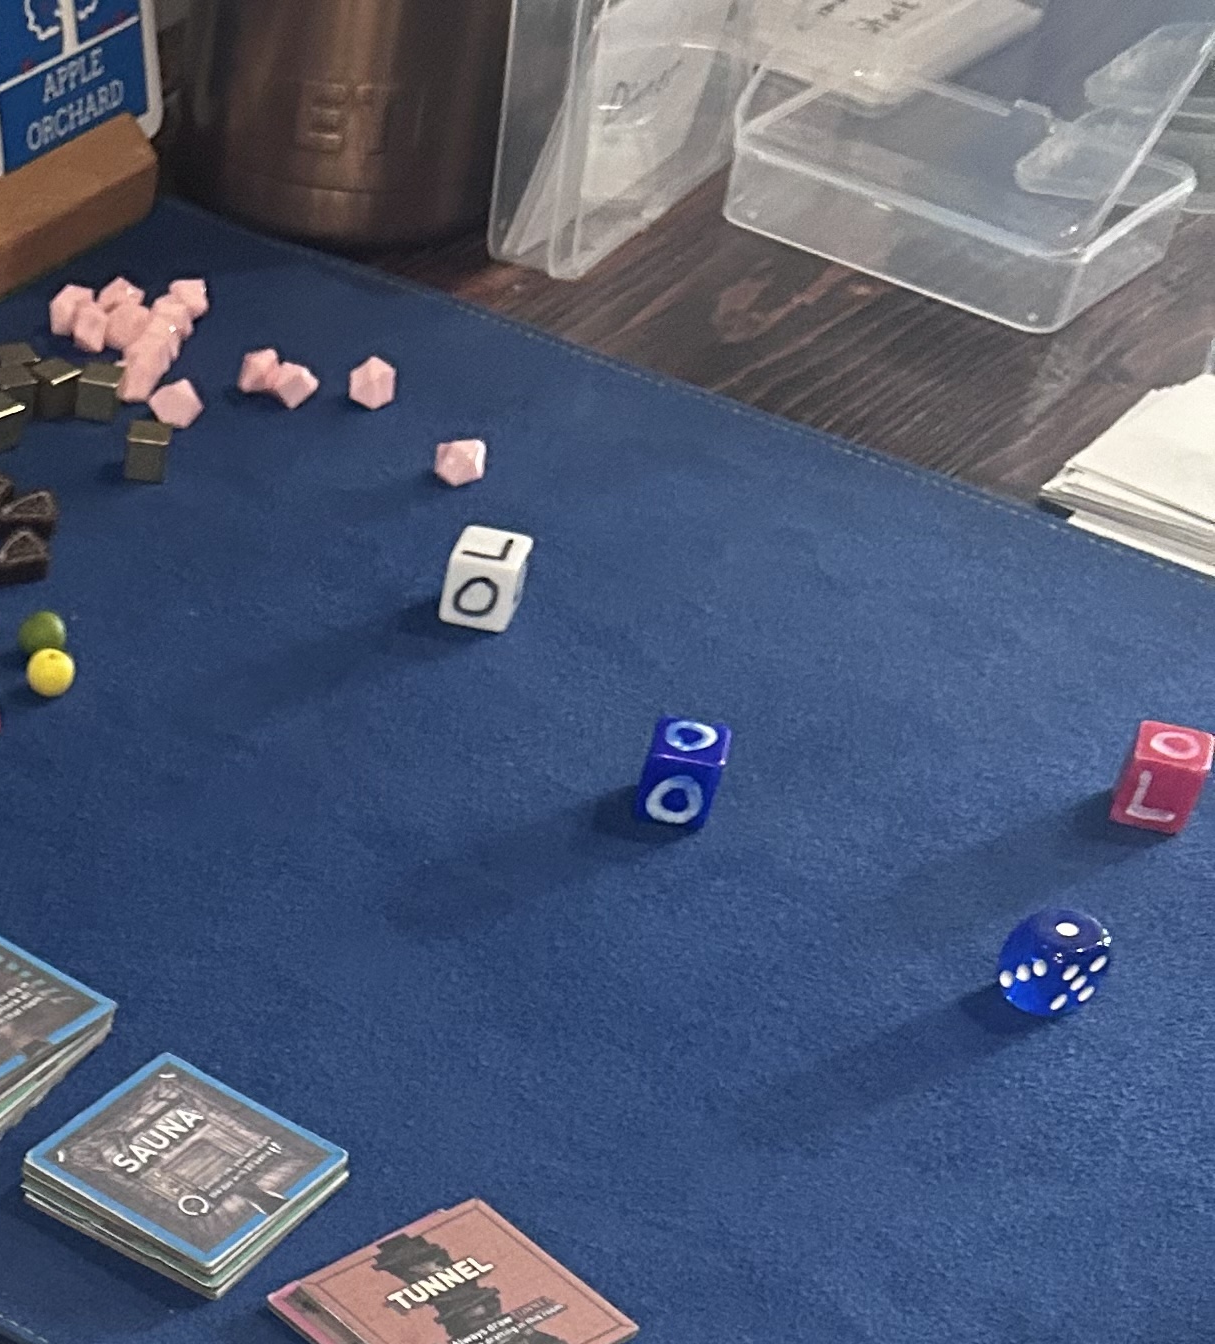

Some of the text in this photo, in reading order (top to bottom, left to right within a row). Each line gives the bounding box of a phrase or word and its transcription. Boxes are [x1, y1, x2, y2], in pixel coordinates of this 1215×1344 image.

[42, 47, 105, 103] APPLE
[27, 79, 125, 151] ORCHARD
[113, 1109, 204, 1173] SAUNA
[387, 1257, 495, 1311] TUNNEL
[486, 1316, 513, 1333] draw
